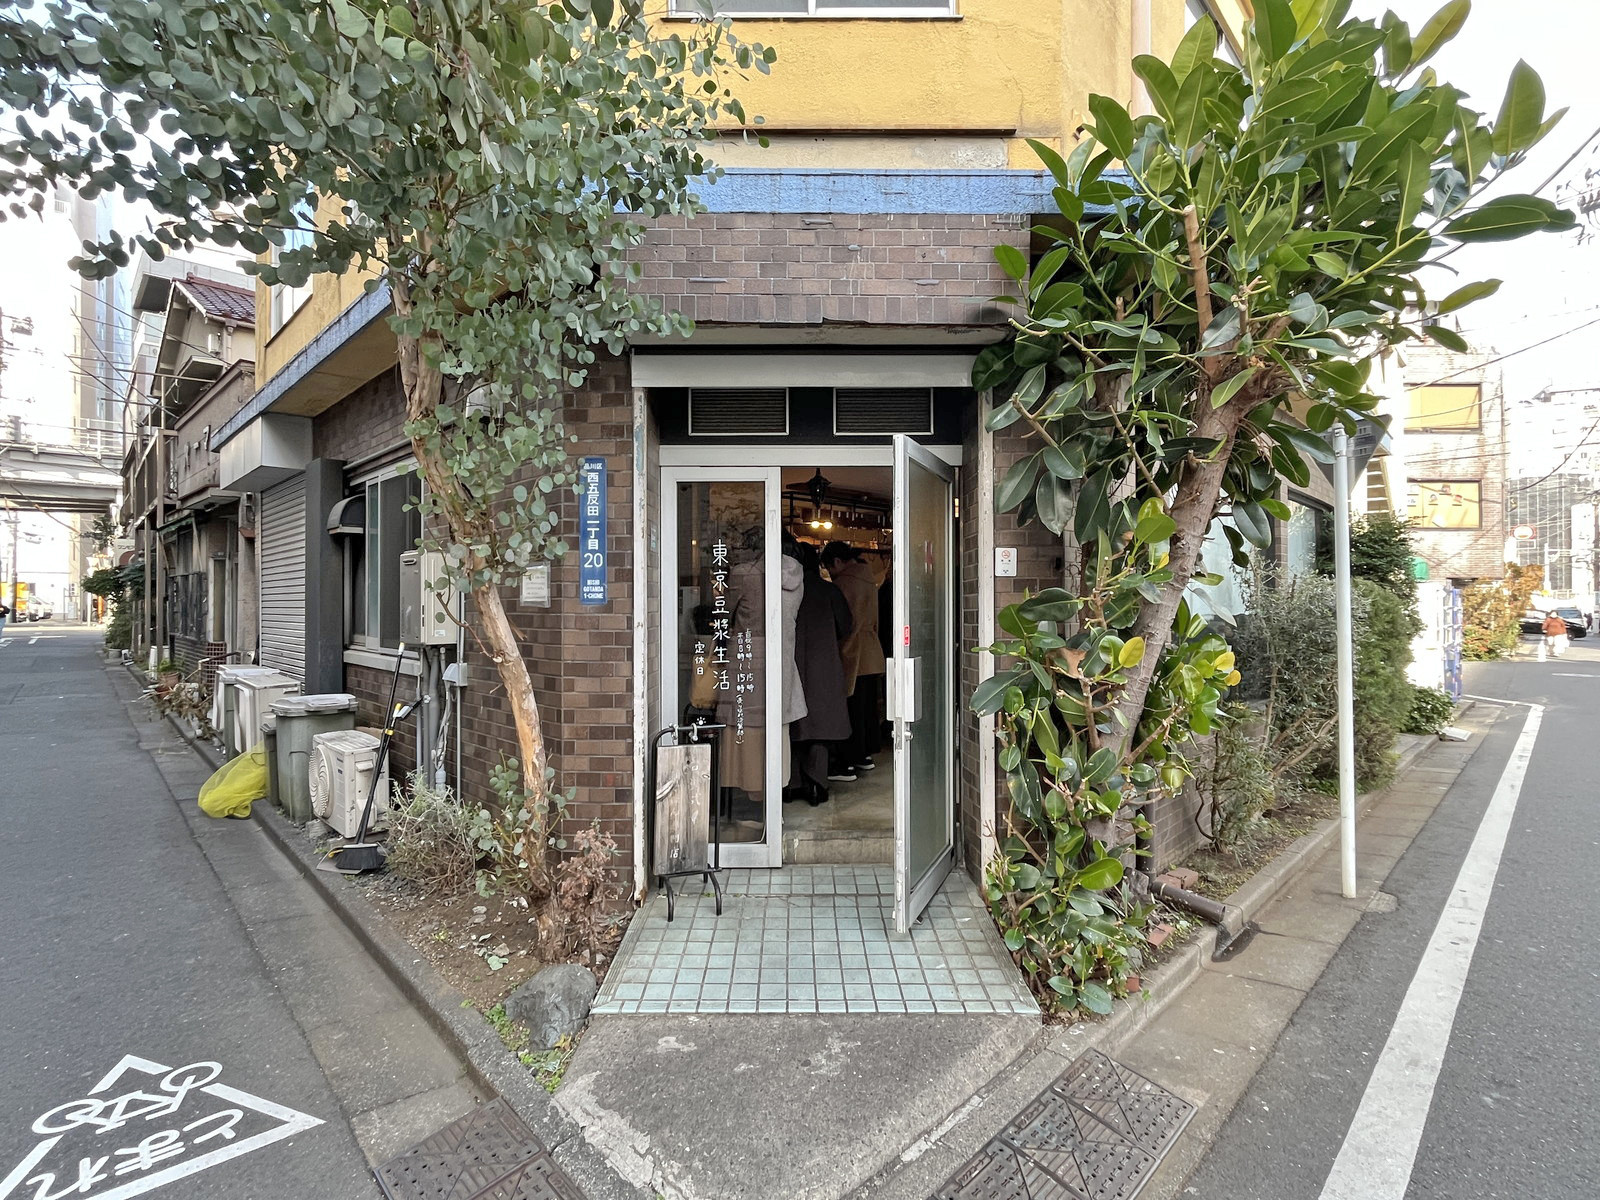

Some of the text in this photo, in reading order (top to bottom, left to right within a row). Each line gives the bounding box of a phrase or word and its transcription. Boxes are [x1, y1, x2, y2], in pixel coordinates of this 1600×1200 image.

[583, 462, 603, 470] 品川区
[586, 472, 600, 550] 西五反田一丁目
[583, 552, 604, 568] 20
[711, 538, 731, 690] 東京豆漿生活
[694, 641, 706, 675] 定休日
[26, 1108, 244, 1200] とまれ
